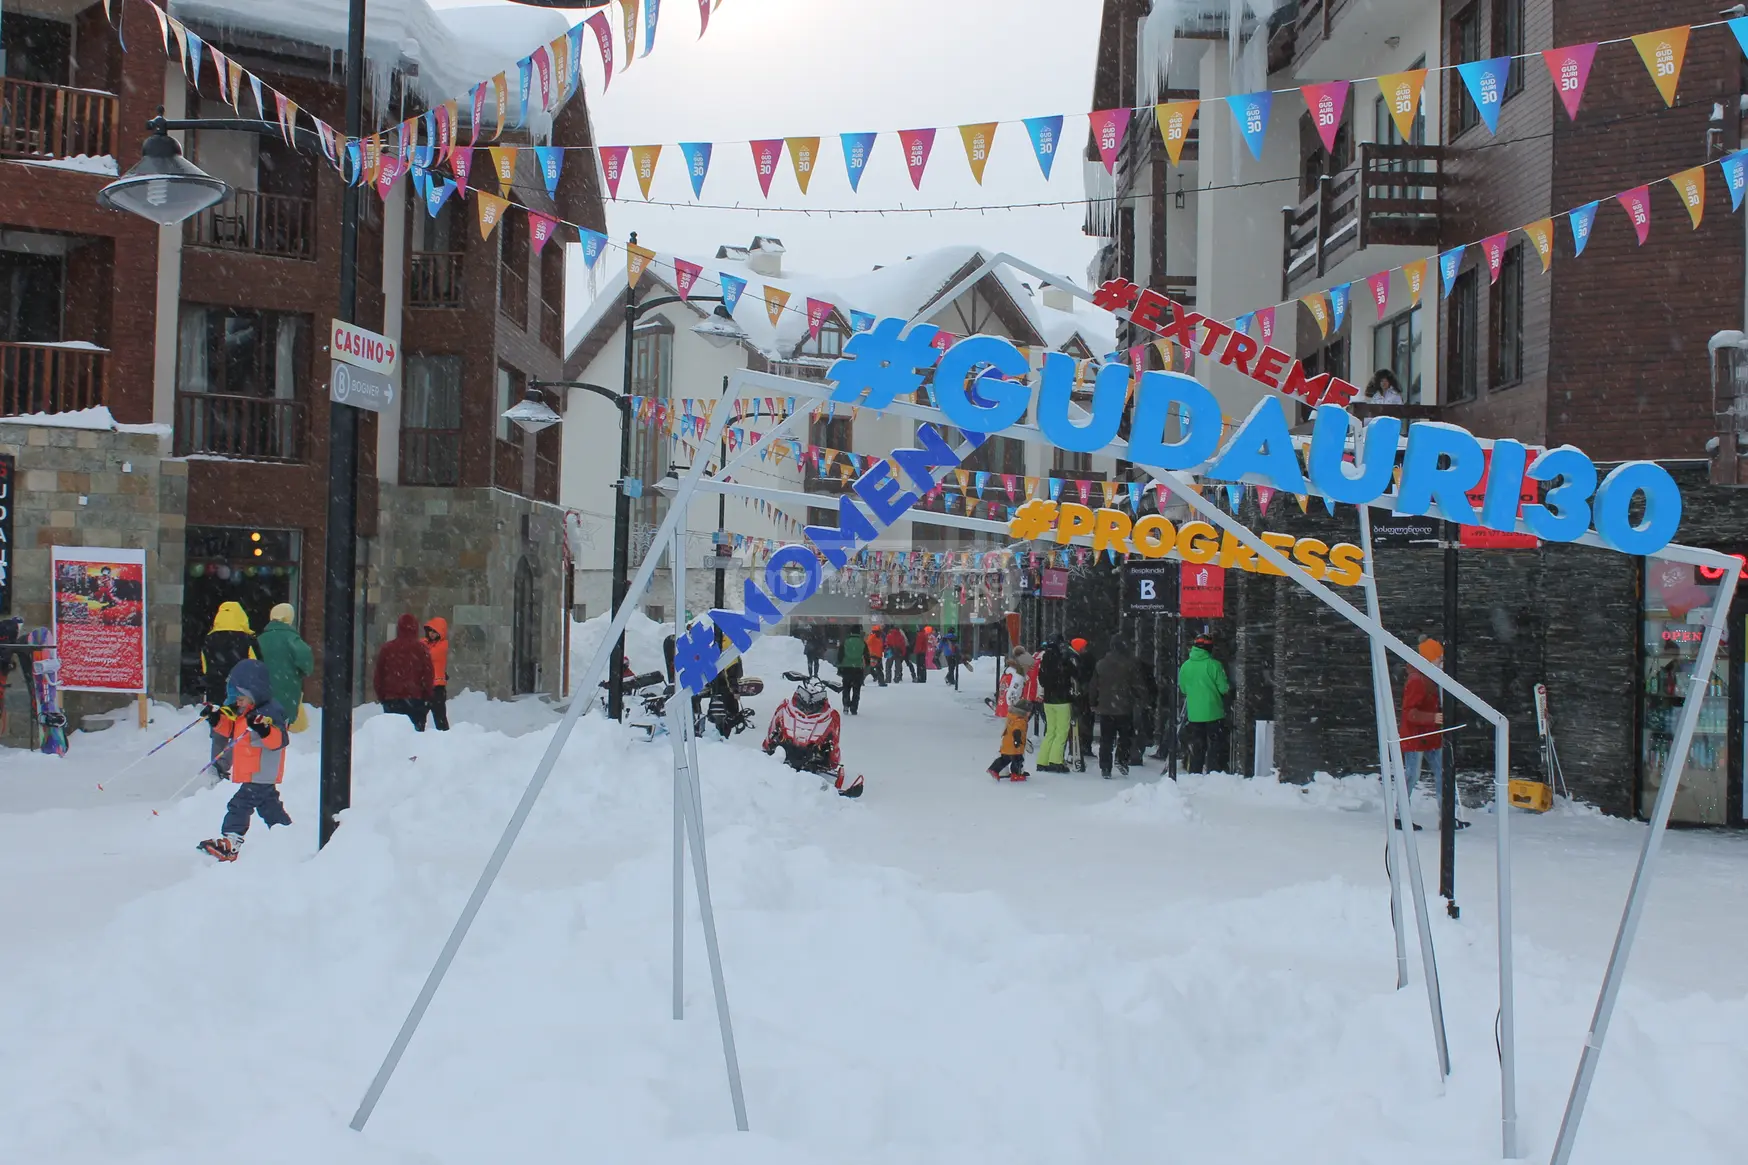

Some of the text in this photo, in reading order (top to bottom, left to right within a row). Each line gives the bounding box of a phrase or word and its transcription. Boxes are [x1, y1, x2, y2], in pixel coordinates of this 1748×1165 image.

[1656, 49, 1672, 57] GUD
[1657, 55, 1673, 63] AURI
[1656, 62, 1674, 76] 30
[1561, 77, 1578, 91] 30
[1481, 90, 1497, 104] 30
[1396, 101, 1411, 114] 30
[1319, 113, 1334, 126] 30
[1247, 121, 1262, 134] 30
[1167, 128, 1180, 140] 30
[1038, 143, 1051, 154] 30
[1102, 138, 1115, 149] 30
[973, 149, 984, 160] 30
[850, 158, 862, 168] 30
[910, 156, 922, 166] 30
[694, 166, 703, 176] 30
[760, 165, 771, 175] 30
[798, 162, 809, 172] 30
[501, 170, 510, 179] 30
[547, 170, 557, 178] 30
[608, 170, 618, 179] 30
[641, 168, 651, 178] 30
[335, 328, 384, 363] CASINO
[352, 380, 380, 397] BOGNER
[827, 318, 1682, 555] #GUDAURI30
[1009, 498, 1365, 586] #PROGRESS
[1141, 580, 1156, 599] B
[1662, 630, 1702, 641] OPEN
